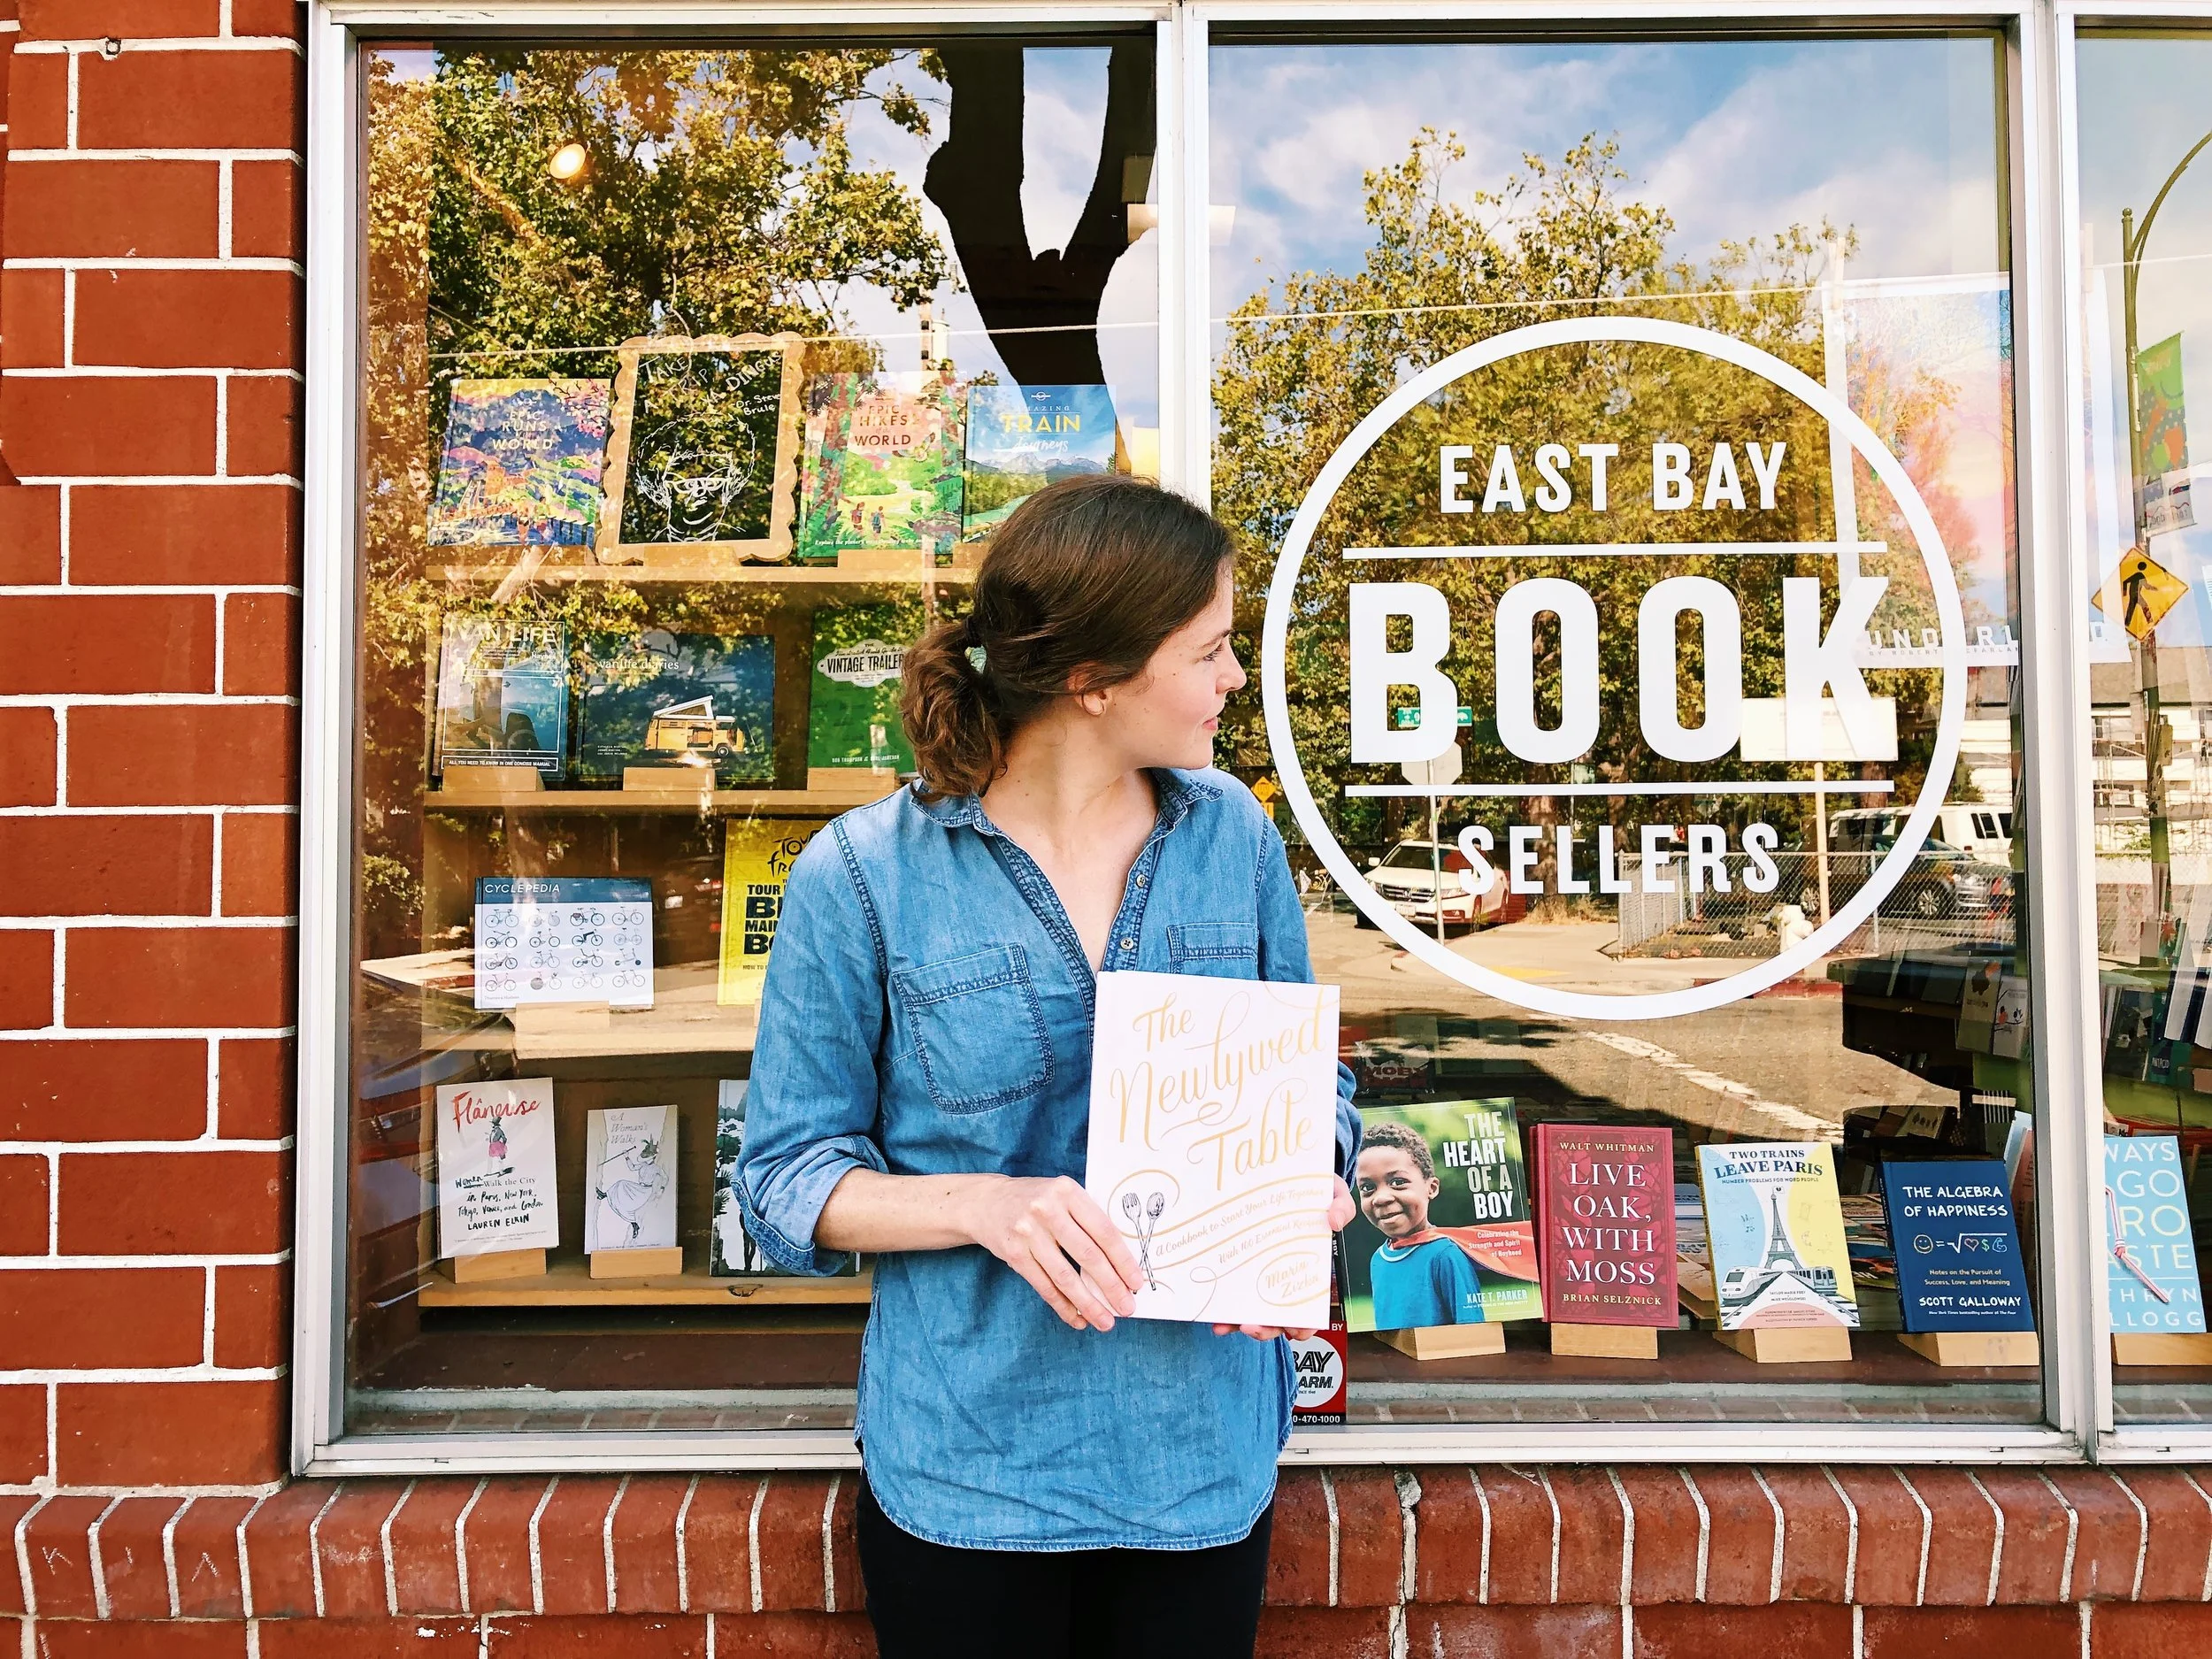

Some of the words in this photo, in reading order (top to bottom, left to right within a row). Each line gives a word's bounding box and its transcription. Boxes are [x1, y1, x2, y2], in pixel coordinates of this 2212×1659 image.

[639, 356, 689, 383] TAKE
[726, 350, 781, 392] DINGUS
[644, 399, 659, 413] A
[663, 368, 709, 402] TRIP
[510, 411, 541, 420] EPIC
[743, 403, 776, 416] Brule
[869, 405, 900, 414] EPIC
[503, 420, 547, 432] RUNS
[859, 415, 908, 426] HIKES
[1000, 414, 1080, 433] TRAIN
[492, 438, 553, 450] WORLD
[855, 434, 911, 446] WORLD
[1439, 443, 1618, 514] EAST
[1652, 442, 1786, 511] BAY
[457, 625, 502, 641] VAN
[510, 626, 557, 642] LIFE
[599, 657, 638, 669] vanlife
[641, 657, 680, 670] diaries
[827, 657, 864, 673] VINTAGE
[1349, 575, 1889, 764] BOOK
[1456, 822, 1780, 895] SELLERS
[485, 884, 560, 893] CYCLEPEDIA
[747, 884, 780, 895] TOUR
[1132, 991, 1194, 1053] The
[1110, 987, 1326, 1152] Newlywed
[1463, 1111, 1505, 1139] THE
[1187, 1077, 1317, 1191] Table
[1442, 1137, 1506, 1167] HEART
[1595, 1143, 1655, 1152] WHITMAN
[1729, 1150, 1758, 1159] TWO
[1760, 1149, 1805, 1158] TRAINS
[1467, 1165, 1492, 1193] OF
[1499, 1164, 1513, 1191] A
[1569, 1163, 1647, 1187] LIVE
[1714, 1161, 1770, 1179] LEAVE
[1774, 1161, 1823, 1176] PARIS
[456, 1176, 483, 1188] Women
[2116, 1170, 2180, 1198] GO
[1902, 1186, 1933, 1198] THE
[1937, 1186, 2003, 1198] ALGEBRA
[1473, 1191, 1514, 1219] BOY
[1573, 1194, 1651, 1223] OAK,
[1904, 1205, 1922, 1217] OF
[1927, 1204, 2008, 1217] HAPPINESS
[468, 1219, 500, 1230] LAUREN
[505, 1213, 529, 1226] ELKIN
[1156, 1245, 1164, 1256] A
[1165, 1225, 1209, 1252] Cookbook
[1210, 1222, 1219, 1232] to
[1220, 1210, 1244, 1227] Start
[1245, 1199, 1268, 1215] Your
[1270, 1191, 1286, 1209] Life
[1477, 1230, 1509, 1239] Celebrating
[1562, 1226, 1655, 1252] WITH
[1218, 1244, 1240, 1264] With
[1469, 1241, 1493, 1250] Strength
[1566, 1259, 1655, 1285] MOSS
[1466, 1293, 1487, 1304] KATE
[1488, 1292, 1495, 1302] T.
[1496, 1289, 1528, 1302] PARKER
[1563, 1294, 1600, 1303] BRIAN
[1603, 1295, 1662, 1305] SELZNICK
[1918, 1296, 1954, 1306] SCOTT
[1959, 1296, 2022, 1307] GALLOWAY
[1332, 1323, 1343, 1332] BY
[1293, 1415, 1340, 1424] 0-470-1000
